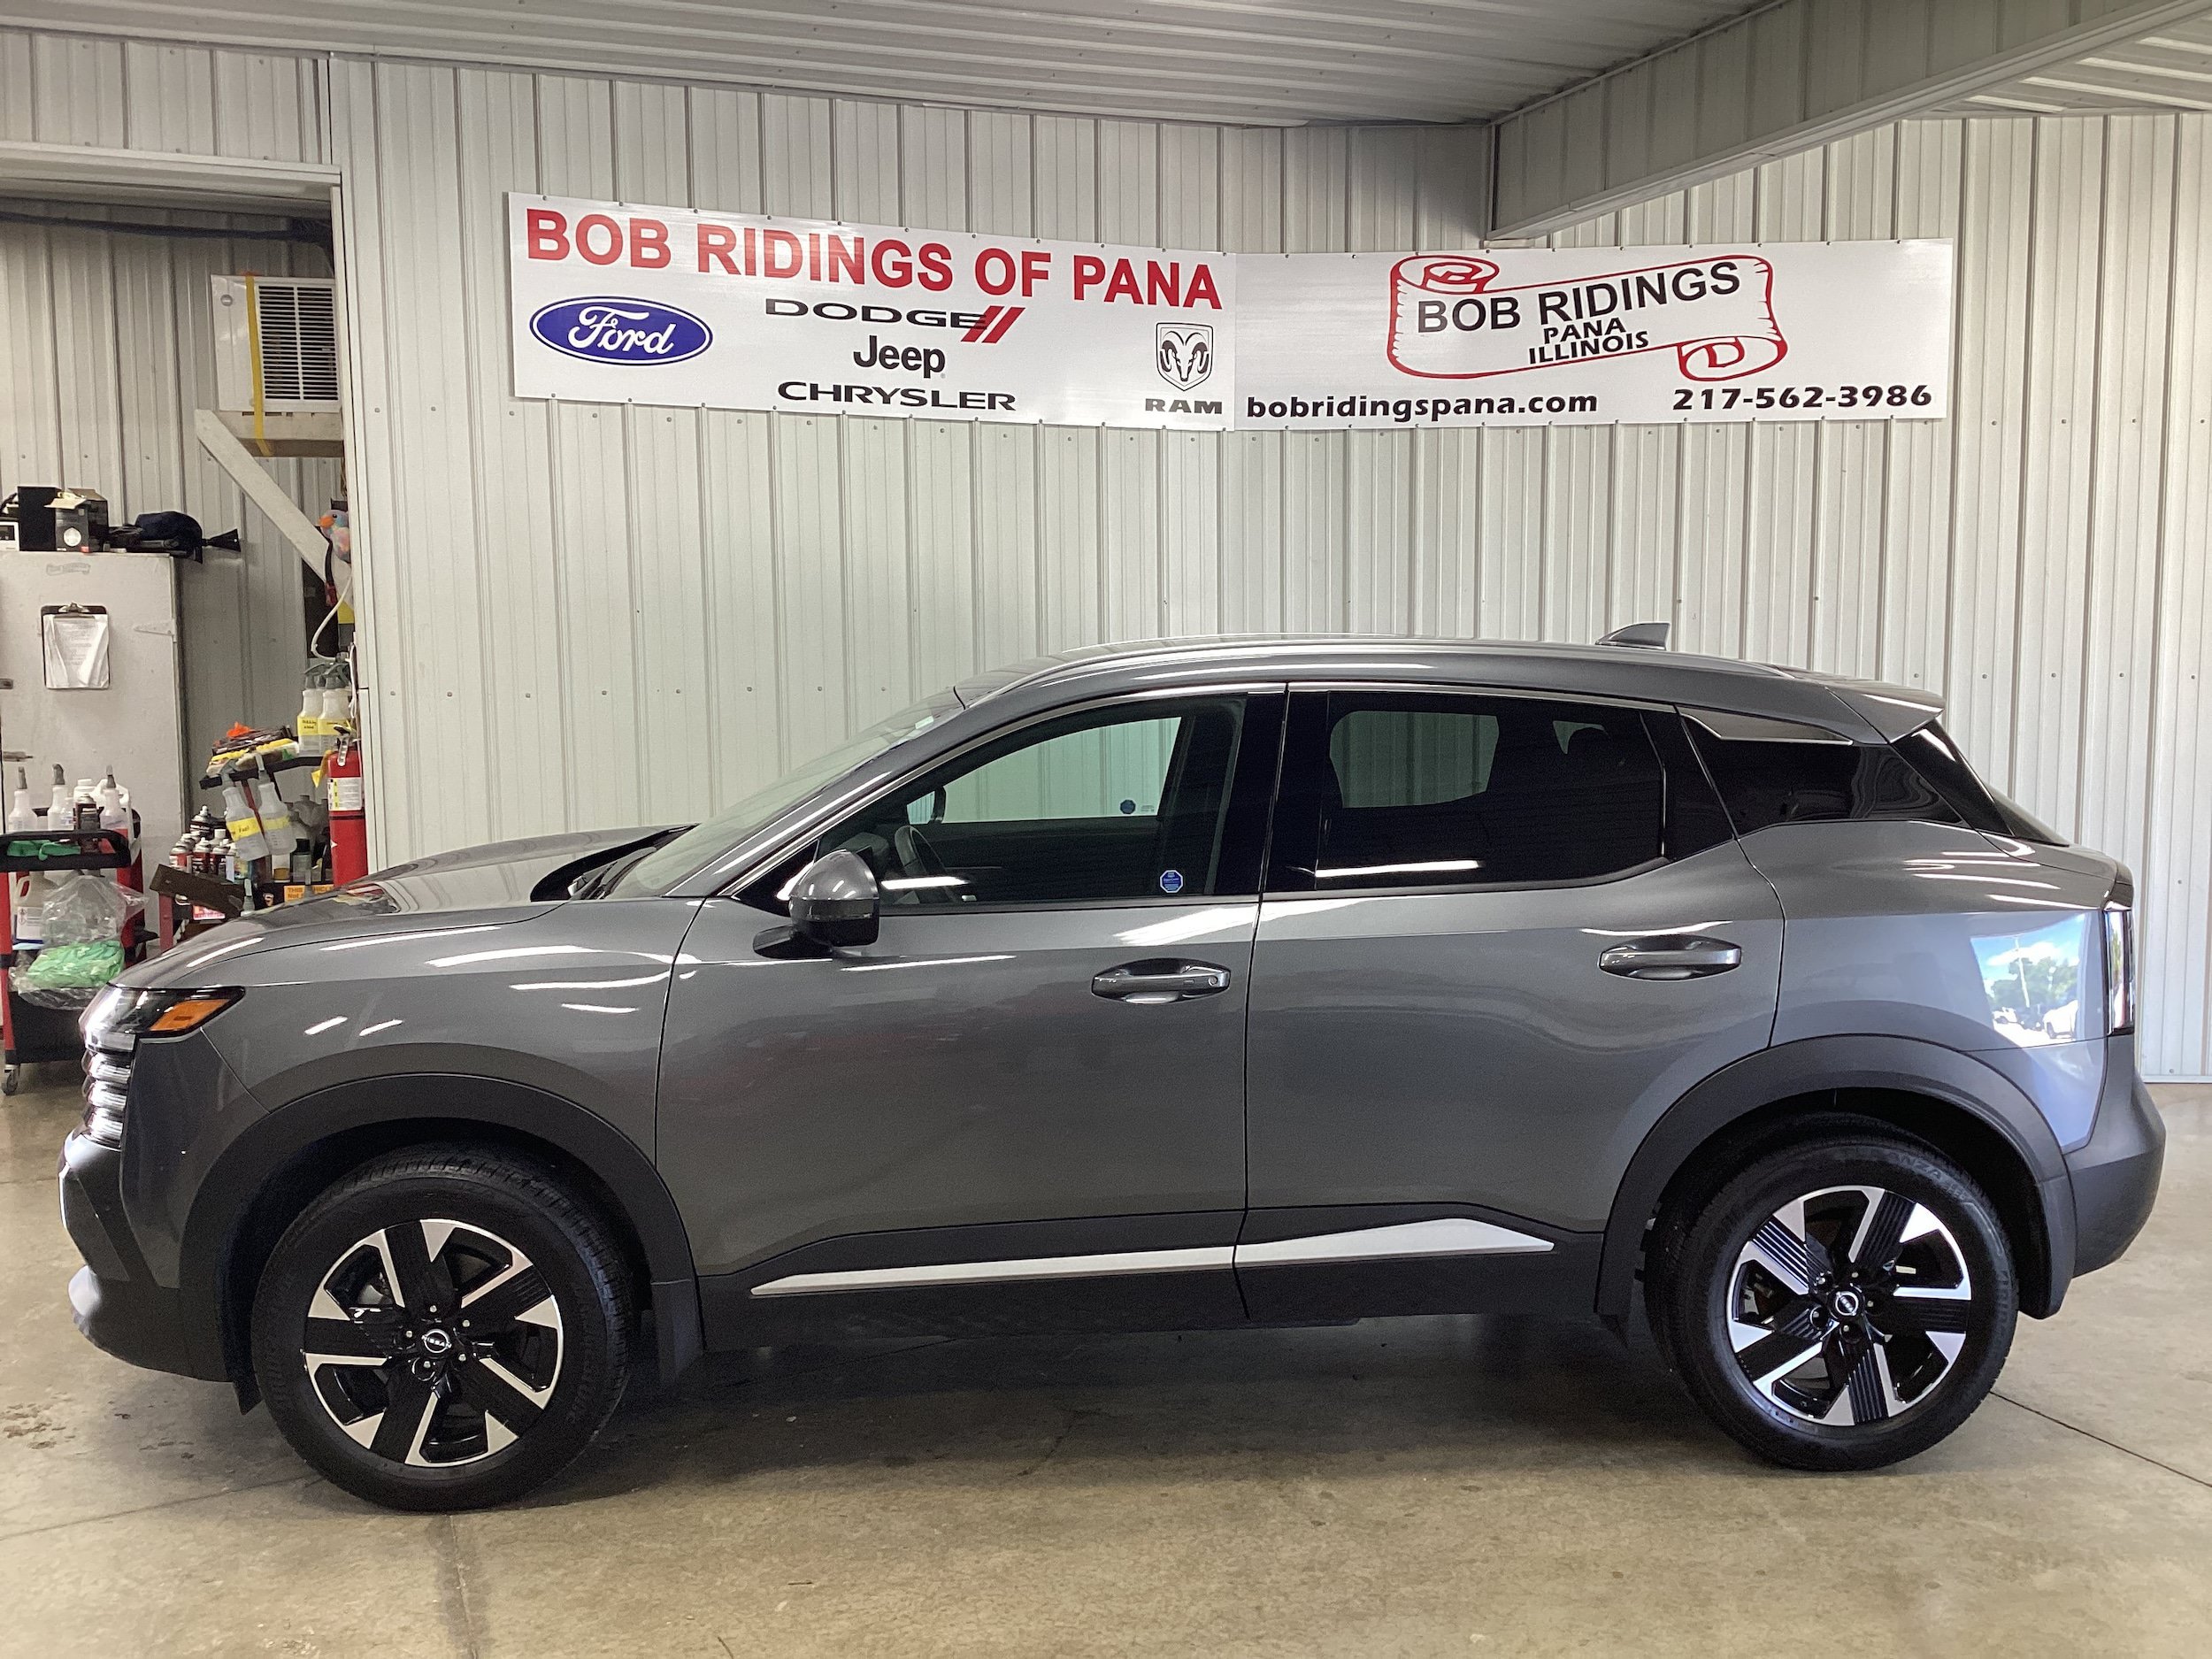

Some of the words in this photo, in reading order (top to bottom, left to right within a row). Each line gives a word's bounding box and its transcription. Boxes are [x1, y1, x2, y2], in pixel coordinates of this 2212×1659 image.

[526, 208, 672, 269] BOB
[697, 224, 953, 292] RIDINGS
[974, 247, 1052, 298] OF
[1073, 254, 1223, 311] PANA
[1417, 296, 1521, 334] BOB
[1538, 261, 1740, 326] RIDINGS
[568, 306, 677, 355] Ford
[765, 298, 987, 331] DODGE
[1543, 317, 1627, 345] PANA
[853, 334, 946, 380] Jeep
[1528, 330, 1650, 365] ILLINOIS
[778, 381, 1018, 411] CHRYSLER
[1144, 397, 1224, 415] RAM
[1247, 395, 1597, 423] bobridingspana.com
[1672, 385, 1932, 411] 217-562-3986
